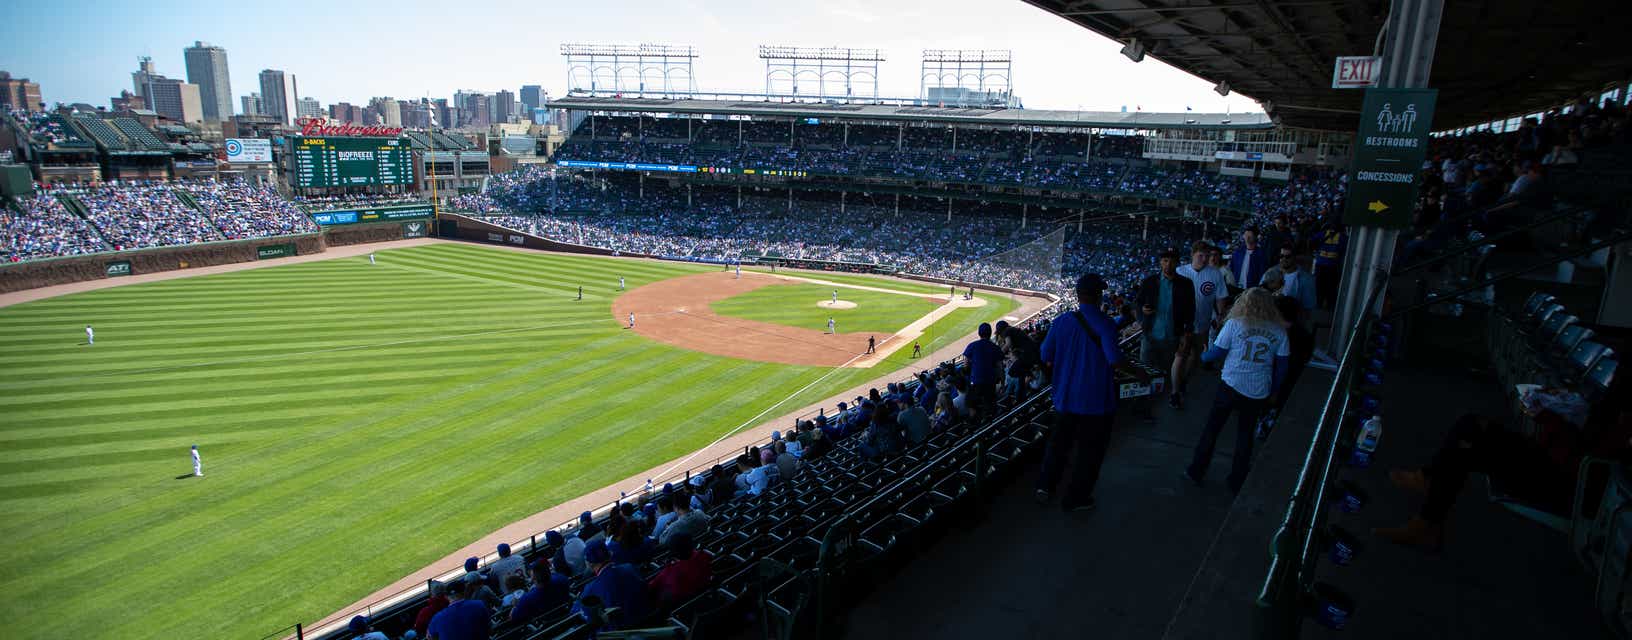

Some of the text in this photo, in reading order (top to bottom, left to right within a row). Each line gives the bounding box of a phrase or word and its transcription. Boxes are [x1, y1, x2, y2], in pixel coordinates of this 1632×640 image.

[1339, 60, 1375, 81] EXIT
[296, 117, 402, 136] Budweiser
[1366, 136, 1419, 148] RESTROOMS
[1357, 170, 1414, 184] CONCESSIONS
[107, 263, 129, 273] ATI
[1241, 341, 1269, 363] 12
